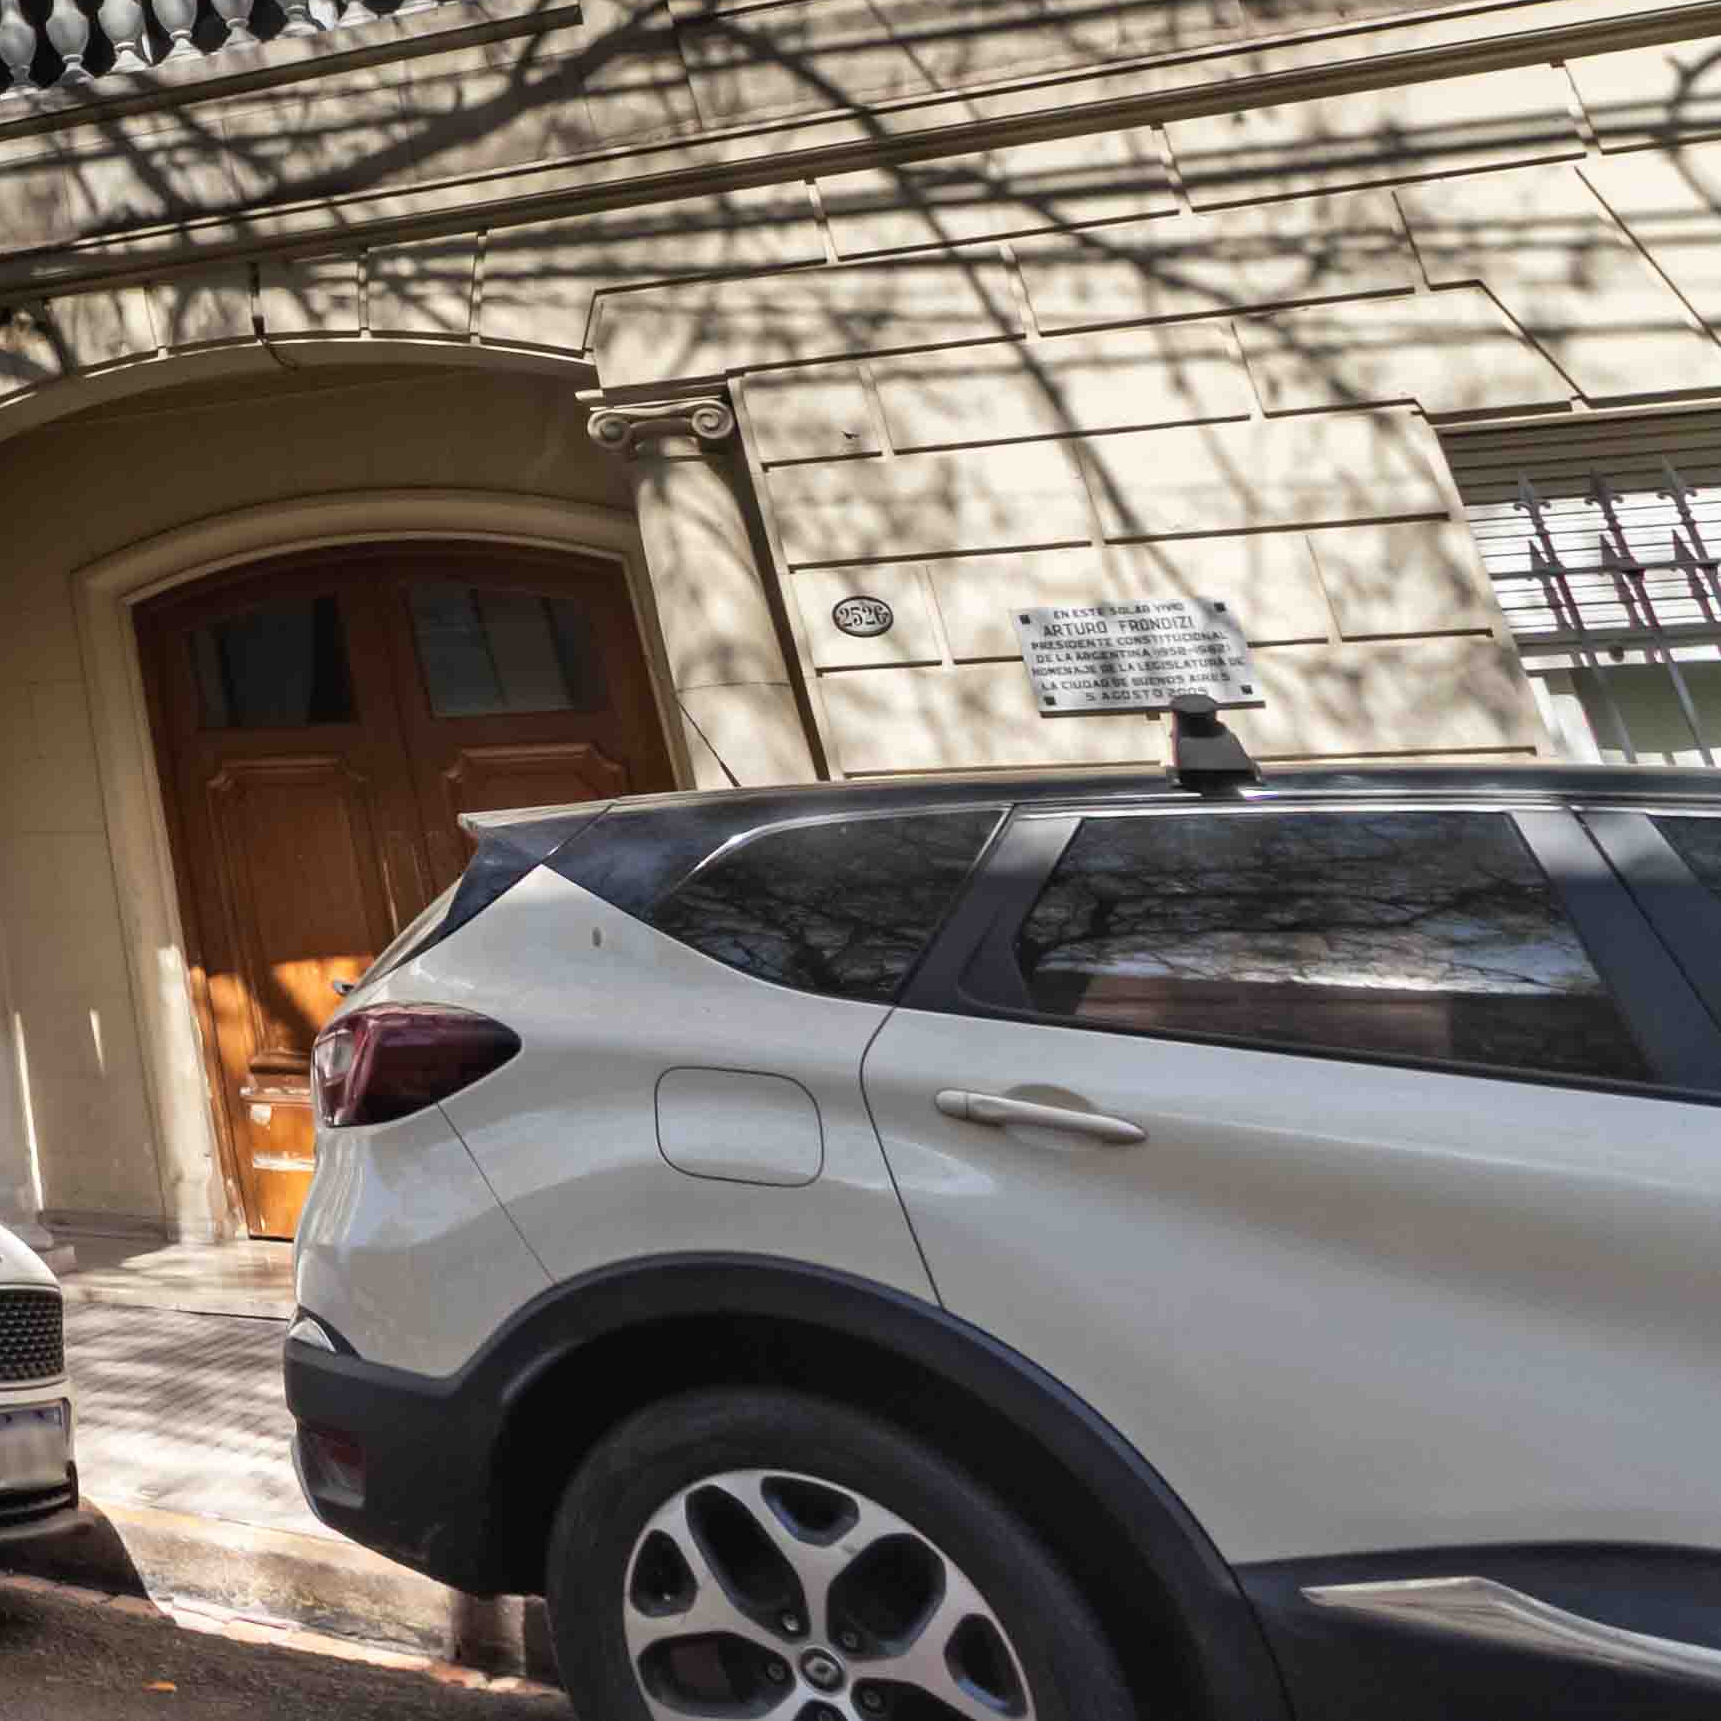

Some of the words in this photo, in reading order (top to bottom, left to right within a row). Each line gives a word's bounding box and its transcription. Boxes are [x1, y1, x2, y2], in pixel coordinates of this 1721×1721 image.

[1043, 621, 1108, 637] ARTURO
[1117, 615, 1195, 632] FRONDIZI
[1030, 638, 1112, 650] PRESIDENTE
[1117, 631, 1228, 645] CONSTITUCIONAL
[1076, 648, 1150, 661] ARGENTINA
[1061, 678, 1109, 689] CIUDAD
[1102, 687, 1163, 700] AGOSTO
